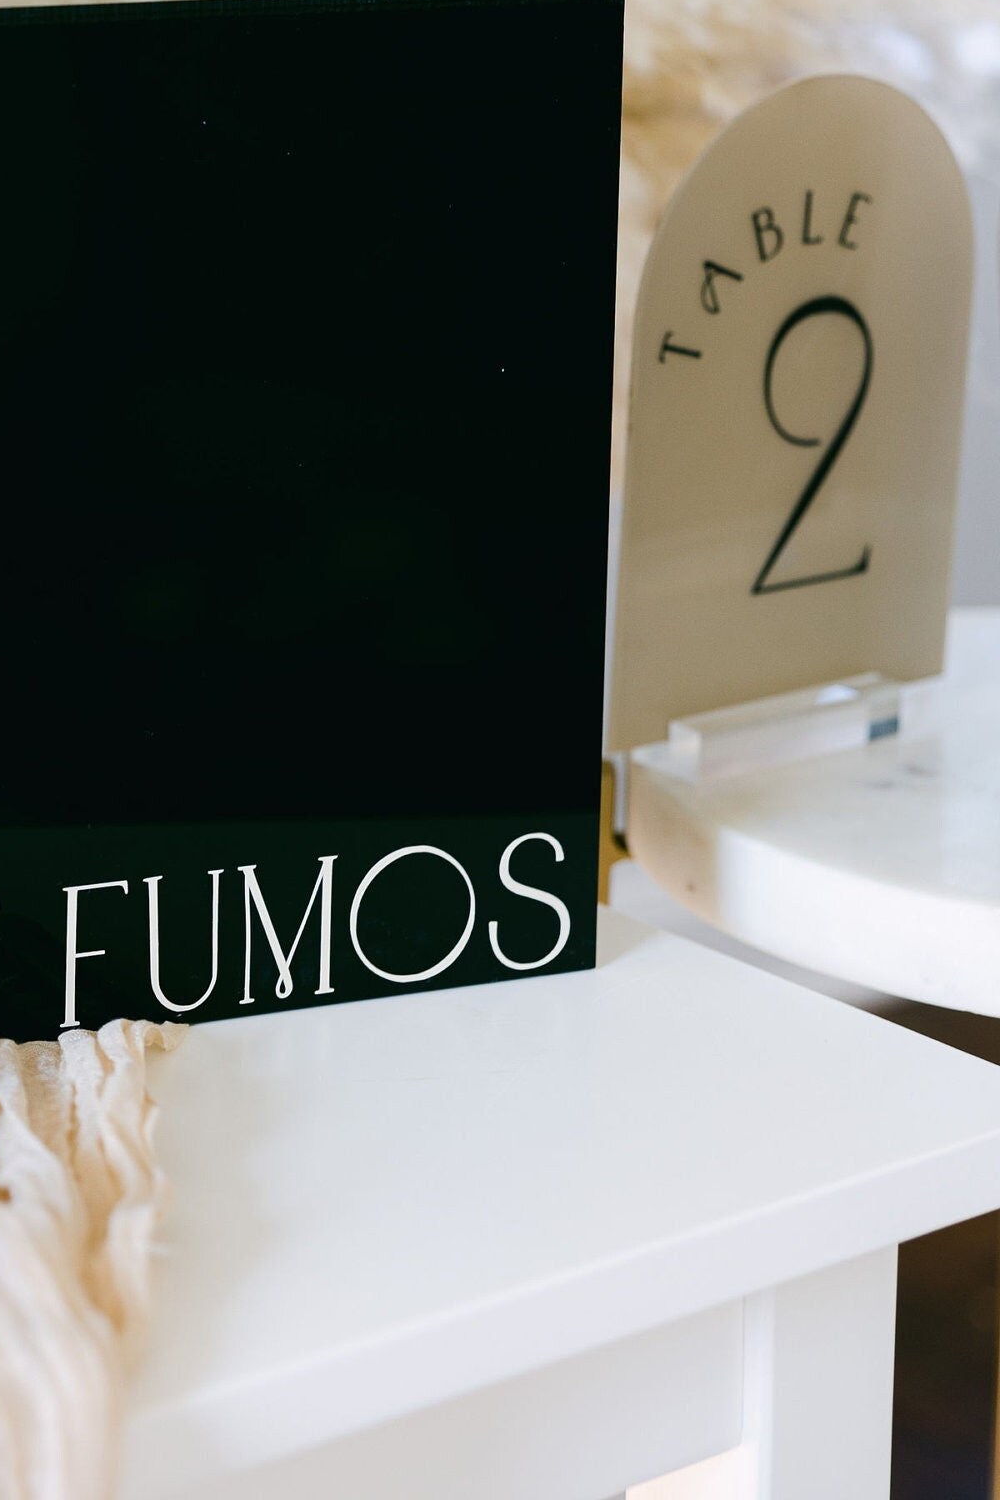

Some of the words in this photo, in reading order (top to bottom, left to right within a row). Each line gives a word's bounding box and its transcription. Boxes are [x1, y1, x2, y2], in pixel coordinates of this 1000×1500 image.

[657, 187, 874, 370] TABLE
[748, 294, 876, 598] 2
[58, 832, 571, 1028] FUMOS
